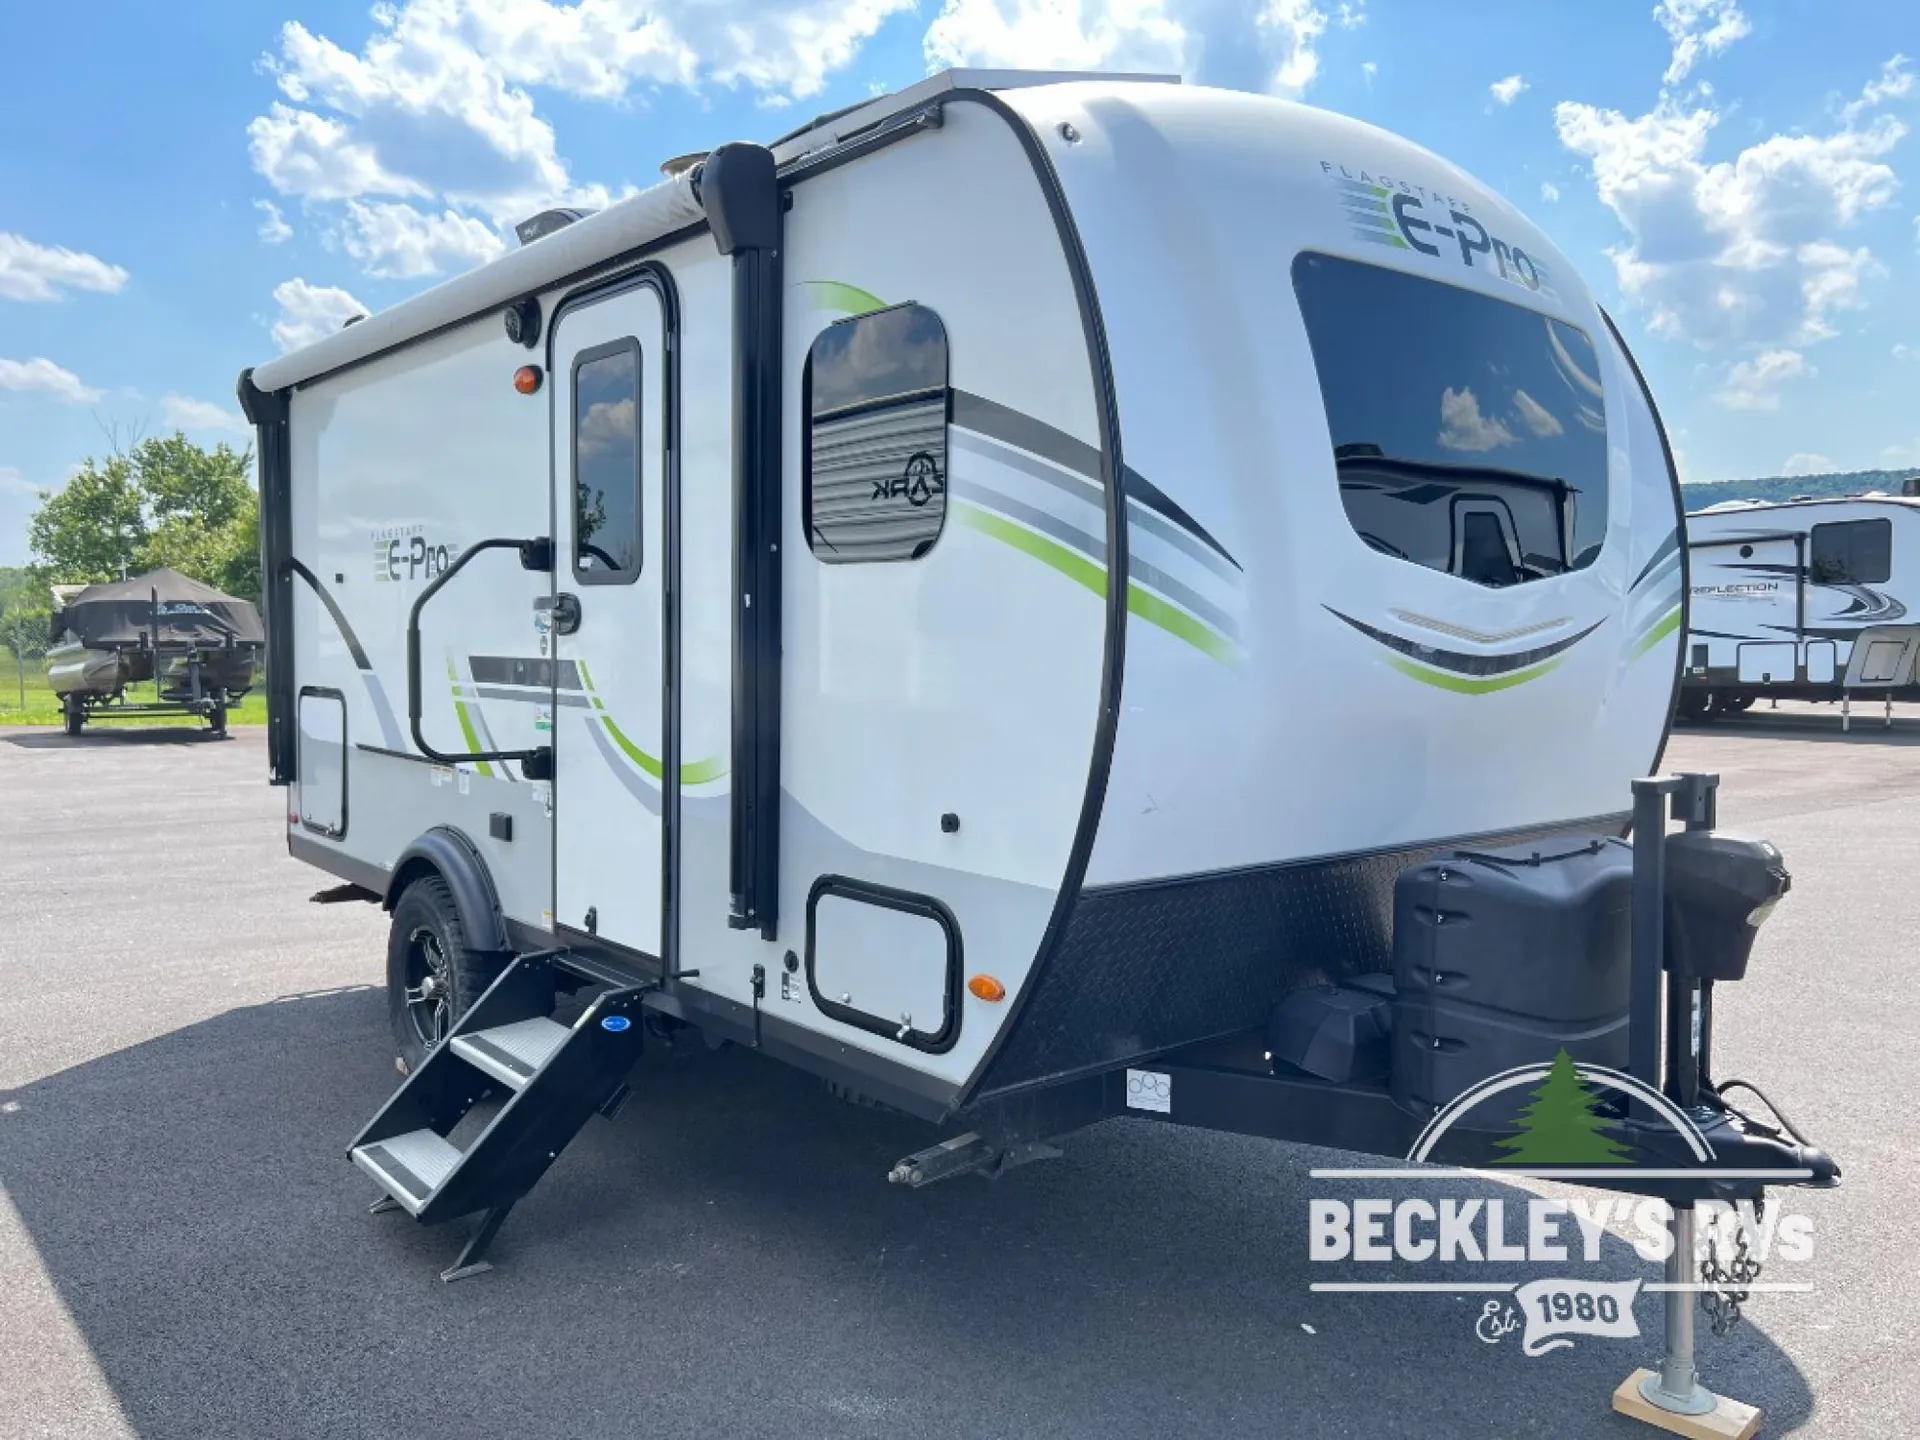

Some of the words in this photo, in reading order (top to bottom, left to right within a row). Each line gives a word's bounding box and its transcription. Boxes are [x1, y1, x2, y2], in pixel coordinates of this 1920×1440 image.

[1319, 160, 1470, 214] FLAGSTAFF
[1392, 192, 1540, 291] E-Pro
[388, 535, 449, 581] E-Pro
[1690, 582, 1779, 594] REFLECTION
